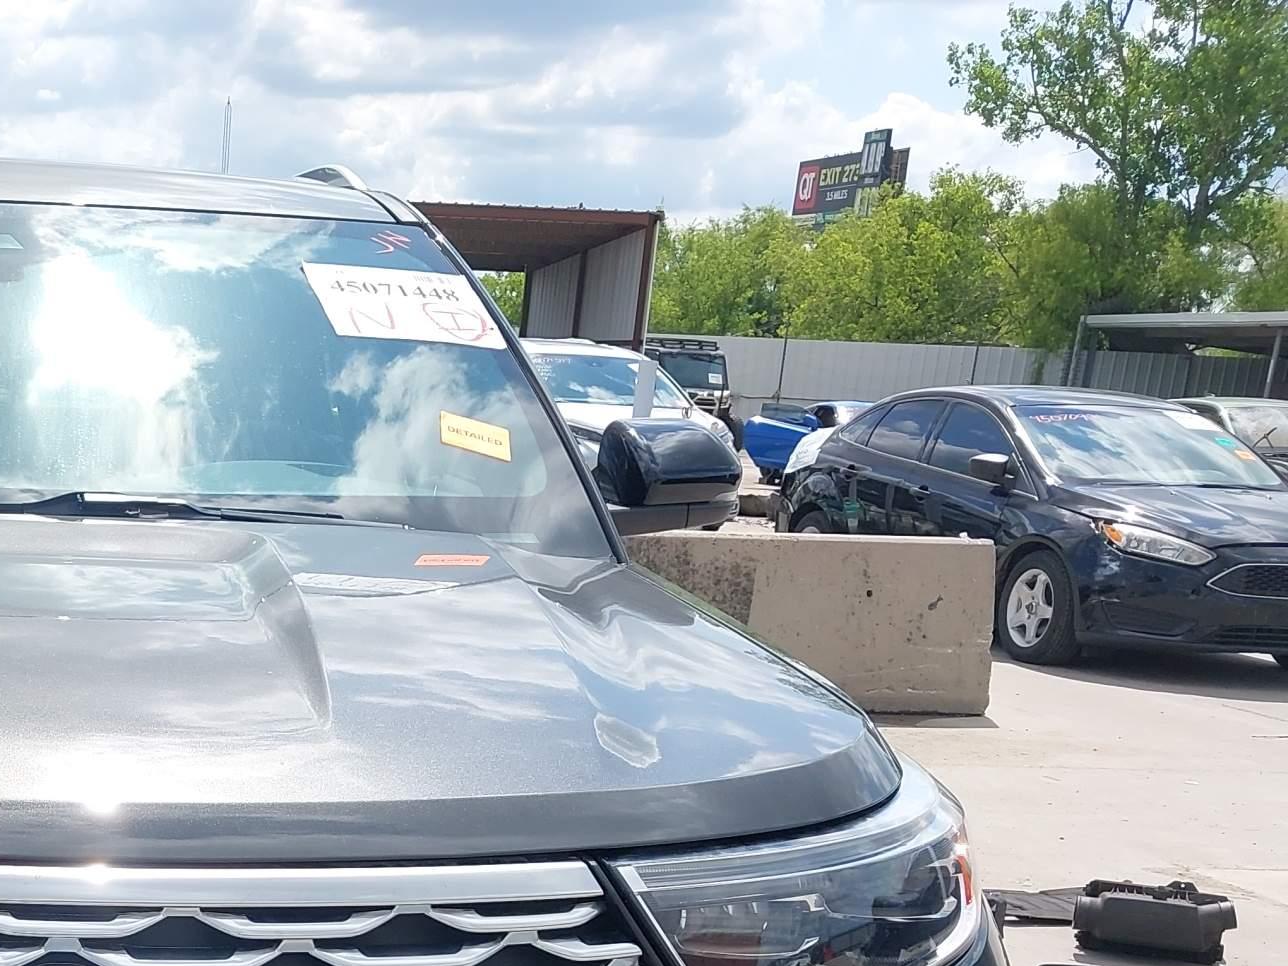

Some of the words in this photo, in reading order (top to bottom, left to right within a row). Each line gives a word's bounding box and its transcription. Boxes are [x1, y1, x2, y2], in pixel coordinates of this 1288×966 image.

[799, 172, 815, 201] QT
[819, 166, 842, 186] EXIT
[330, 280, 460, 302] 45071448
[447, 425, 503, 446] DETAILED
